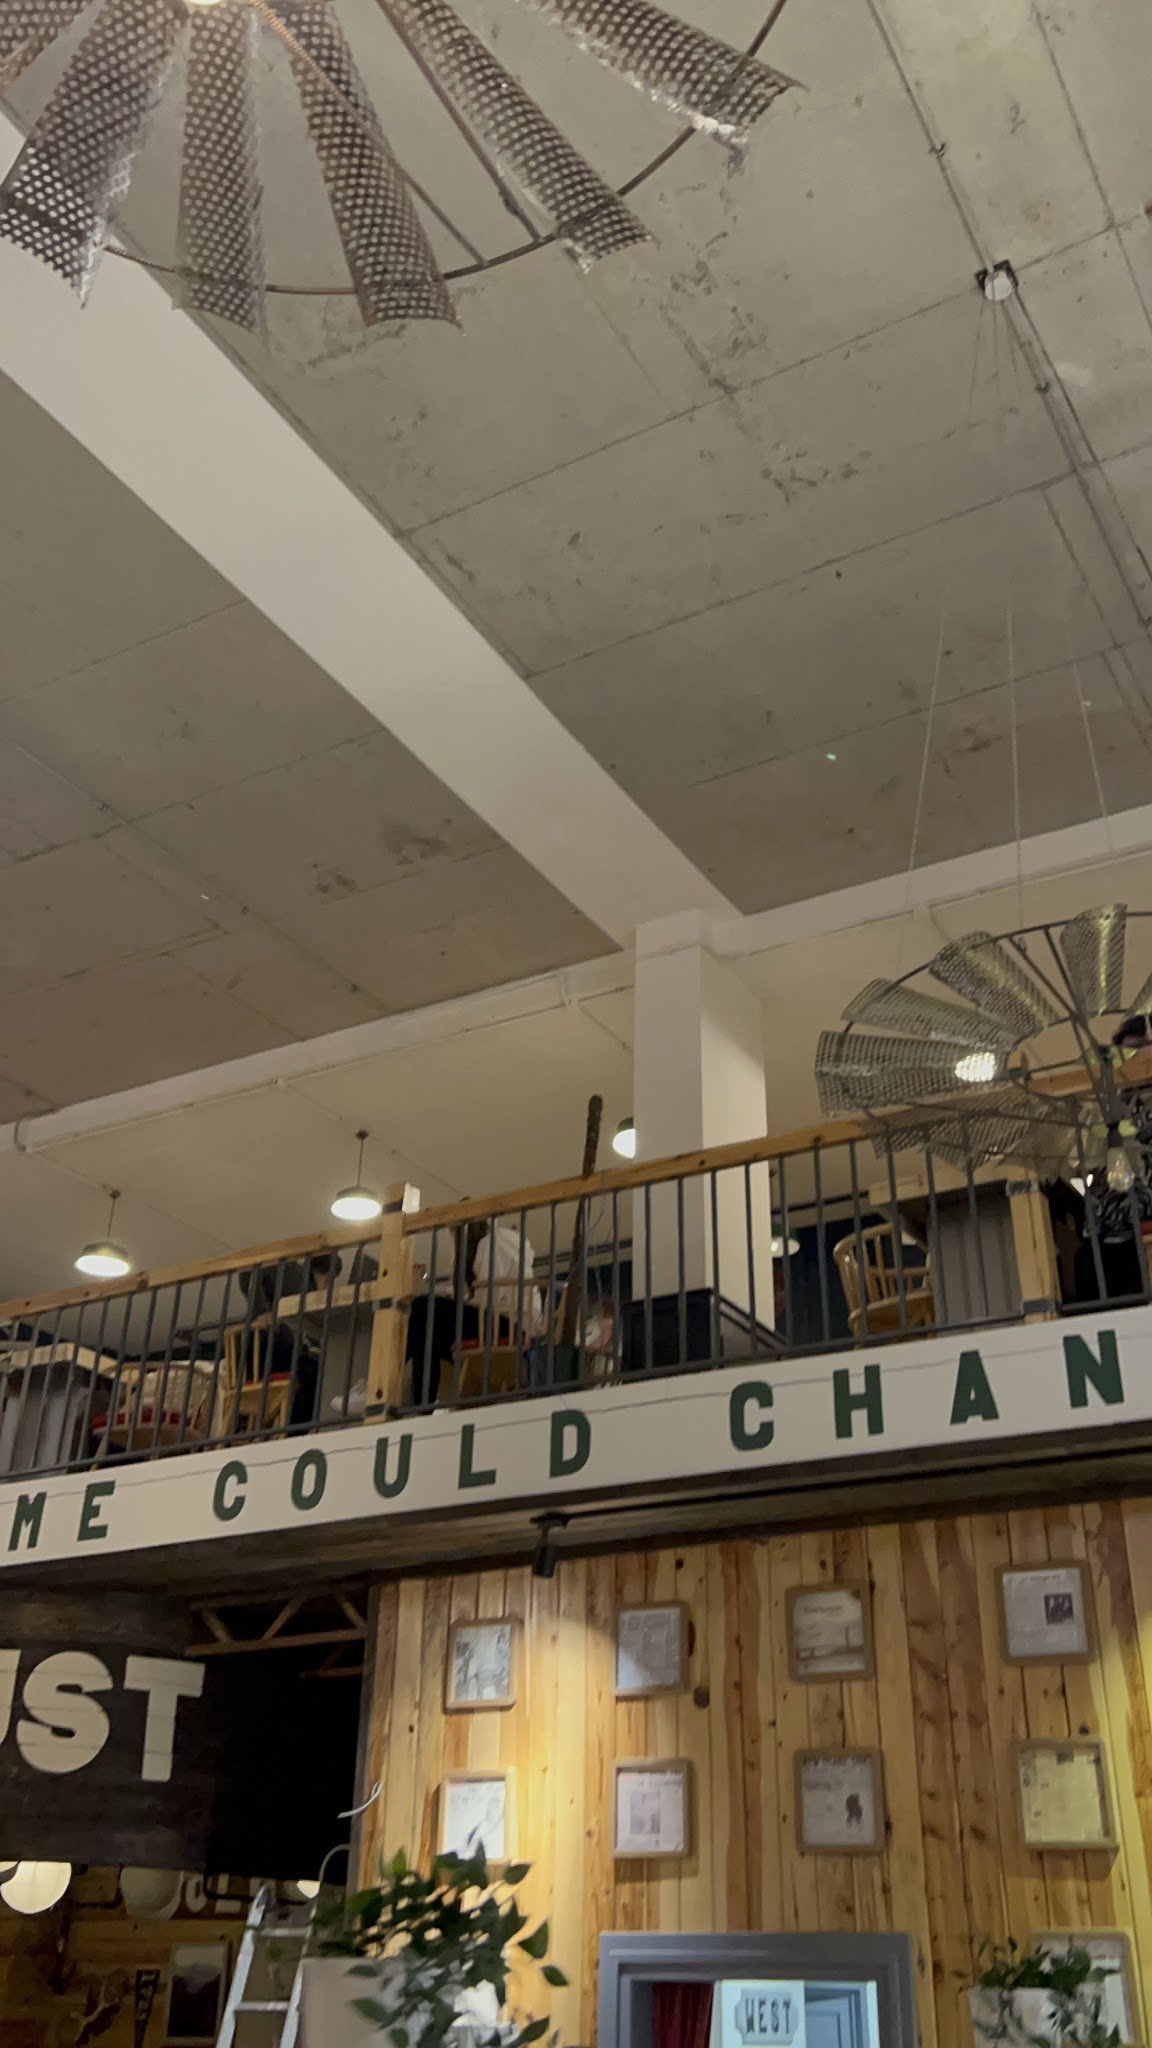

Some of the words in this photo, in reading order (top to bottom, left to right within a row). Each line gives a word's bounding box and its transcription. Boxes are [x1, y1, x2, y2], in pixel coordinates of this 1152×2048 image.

[8, 1480, 117, 1552] ME
[213, 1409, 592, 1521] COULD
[729, 1329, 1125, 1452] CHAN
[0, 1649, 206, 1783] ST
